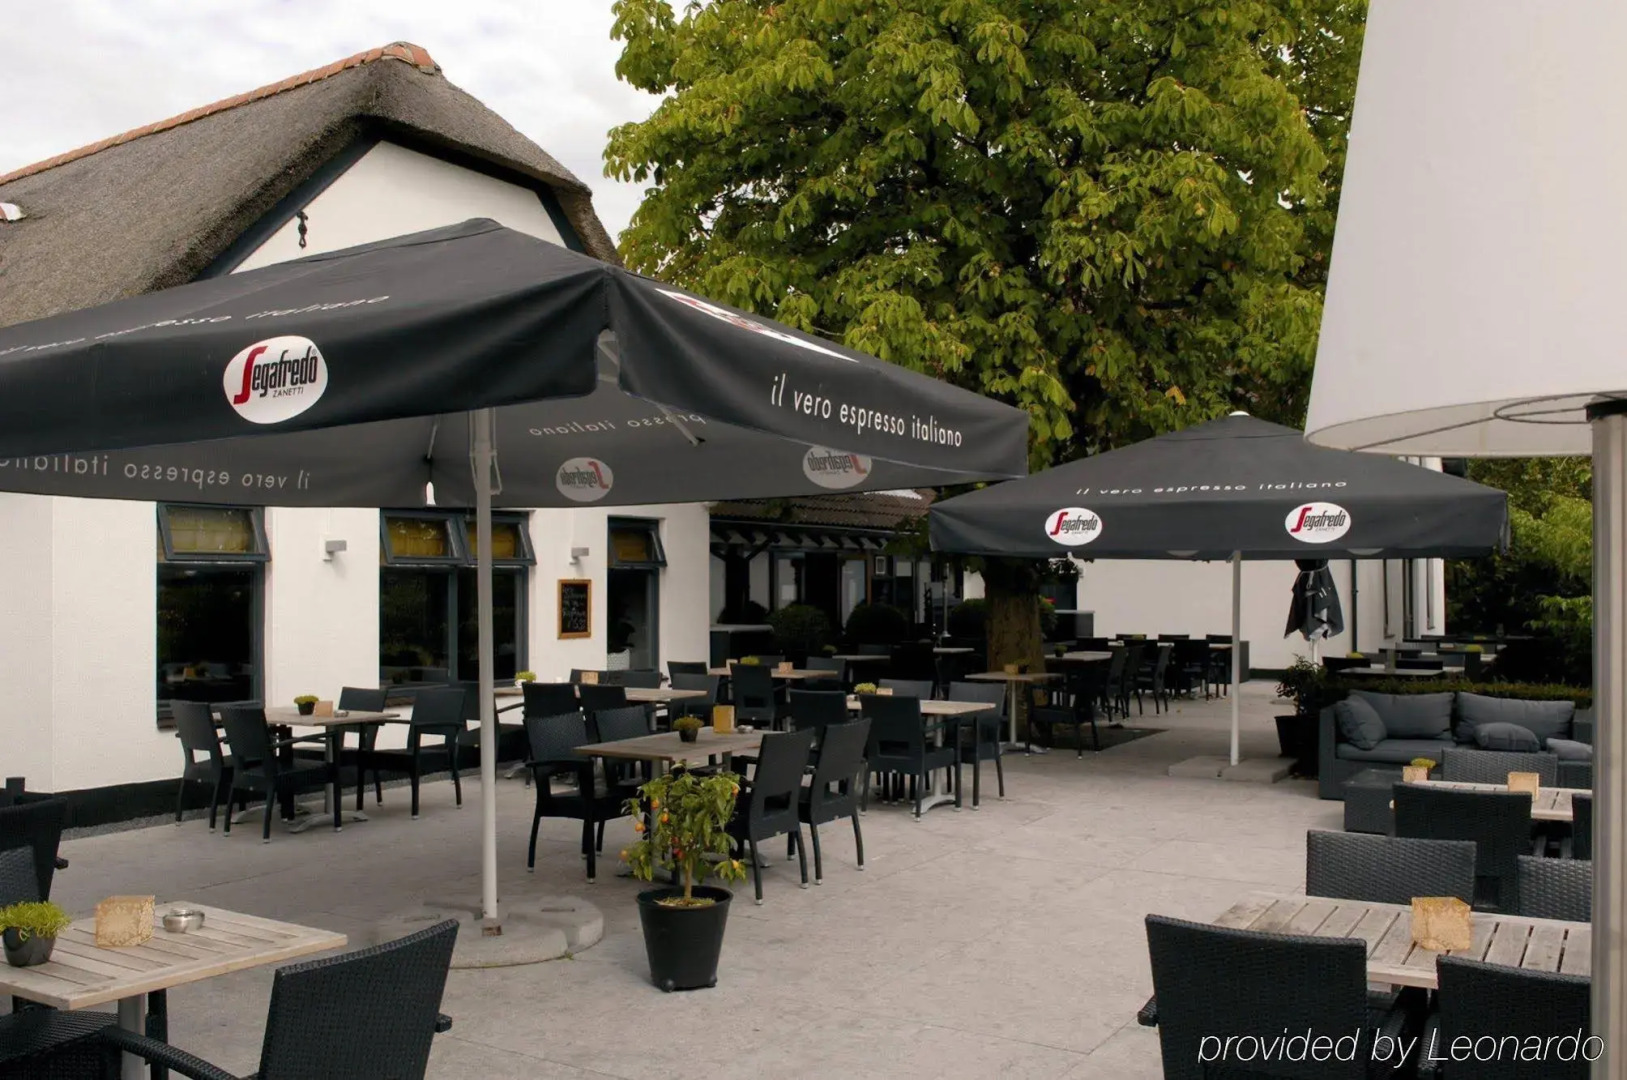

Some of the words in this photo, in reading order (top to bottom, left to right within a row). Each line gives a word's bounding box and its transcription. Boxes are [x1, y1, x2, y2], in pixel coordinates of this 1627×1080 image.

[233, 345, 318, 405] Segafredo
[272, 386, 304, 398] ZANETTI
[771, 373, 786, 407] il
[794, 390, 832, 419] vero
[839, 403, 905, 435] espresso
[912, 415, 962, 447] italiano
[1153, 484, 1246, 493] espresso
[1259, 481, 1347, 490] italiano
[1050, 511, 1098, 535] Segafredo
[1290, 507, 1346, 533] Segafredo
